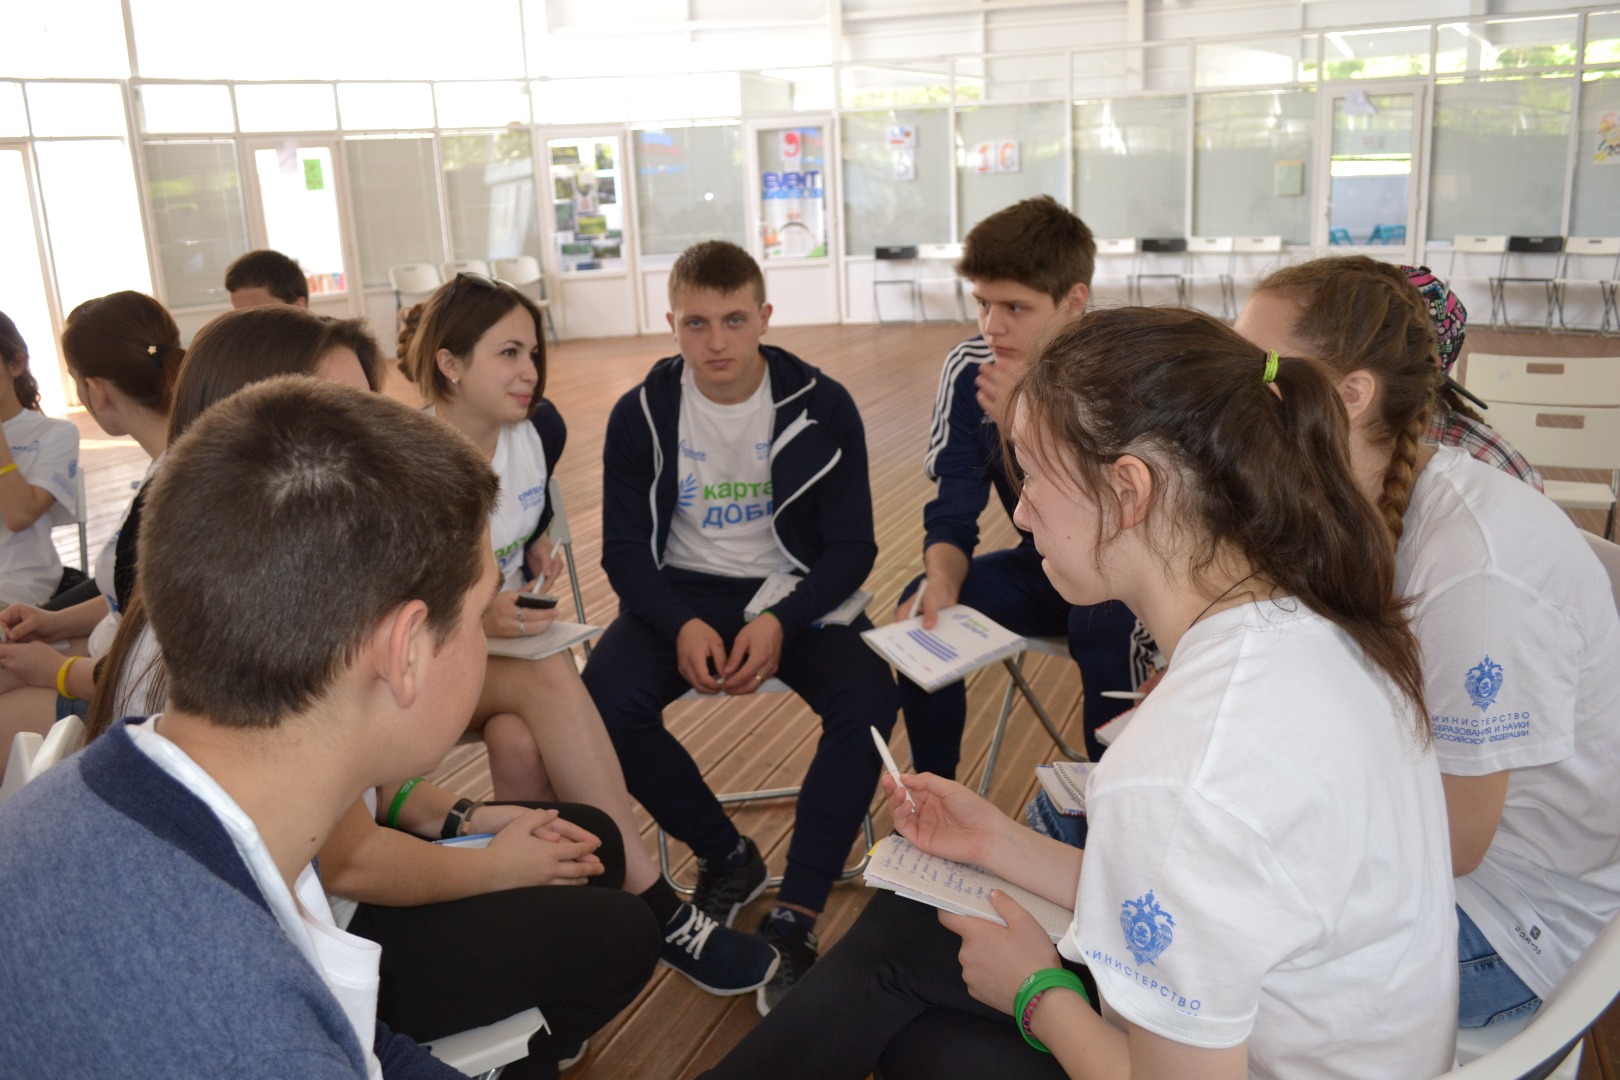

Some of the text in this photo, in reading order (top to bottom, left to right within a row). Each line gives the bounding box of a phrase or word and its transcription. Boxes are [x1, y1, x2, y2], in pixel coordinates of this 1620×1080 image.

[1431, 711, 1530, 728] МИНИСТЕРСТВО
[1432, 721, 1530, 737] ОБРАЗОВАНИЯ И НАУКИ
[1488, 730, 1530, 742] ФЕДЕРАЦИИ
[1514, 925, 1542, 955] DOMYOS
[1085, 950, 1201, 1011] ИНИСТЕРСТВО
